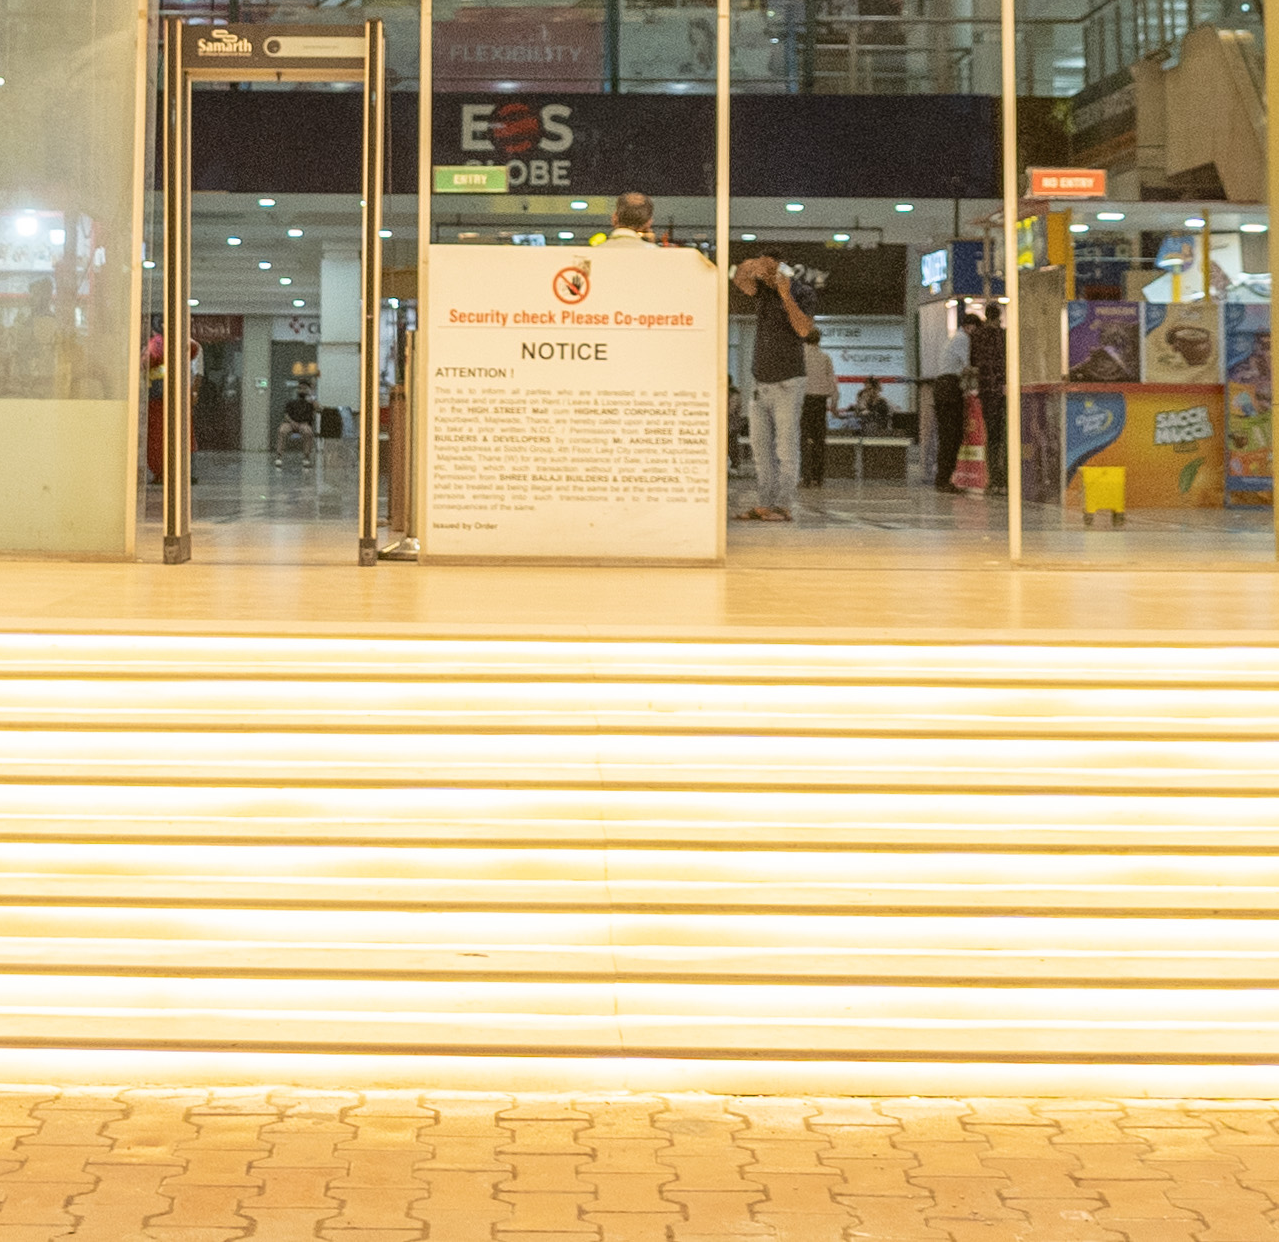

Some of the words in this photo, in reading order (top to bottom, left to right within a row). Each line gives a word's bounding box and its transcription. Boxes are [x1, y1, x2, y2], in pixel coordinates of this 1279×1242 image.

[197, 38, 253, 53] Samarth
[453, 173, 488, 186] ENTRY
[1042, 176, 1059, 189] NO
[1060, 176, 1095, 189] ENTRY
[449, 308, 509, 327] Security
[513, 309, 556, 324] check
[561, 310, 610, 325] Please
[614, 311, 694, 329] Co-operate
[522, 342, 608, 360] NOTICE
[435, 367, 507, 378] ATTENTION
